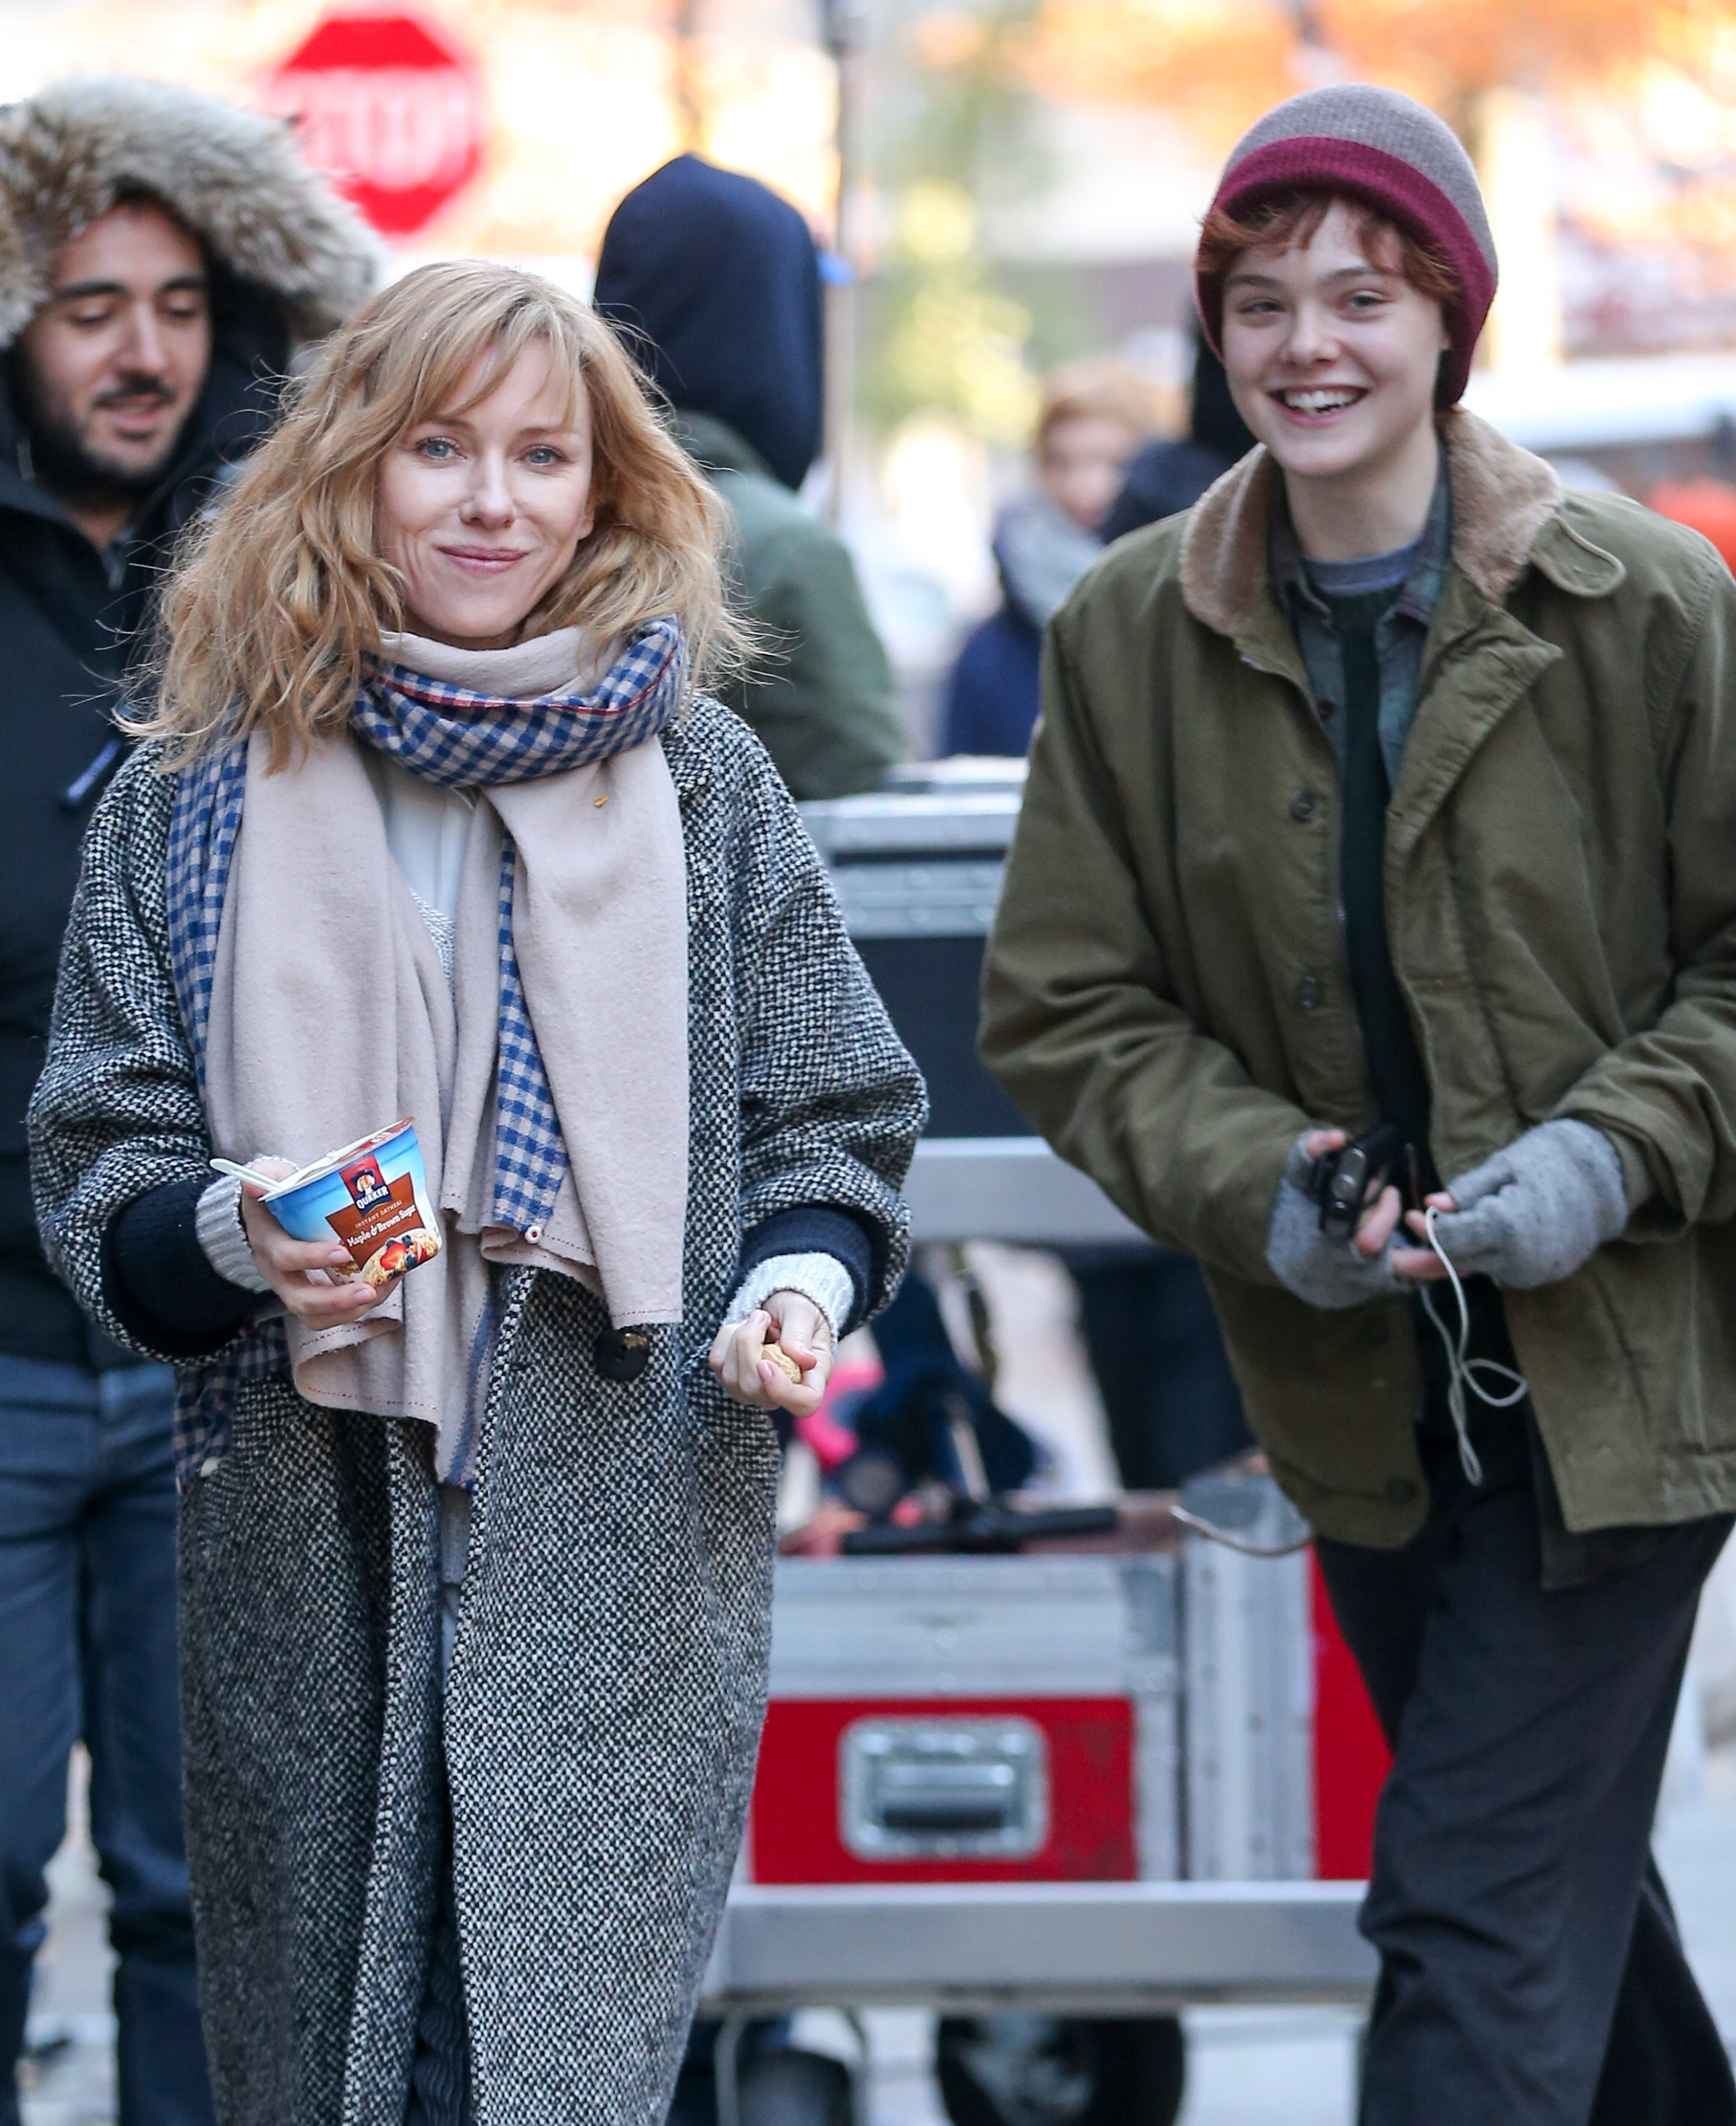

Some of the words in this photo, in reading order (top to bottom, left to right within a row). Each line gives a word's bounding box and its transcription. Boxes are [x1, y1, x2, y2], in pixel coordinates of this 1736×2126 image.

[356, 1186, 390, 1209] QUAKER
[346, 1231, 371, 1247] Maple
[370, 1225, 378, 1236] &
[376, 1215, 401, 1233] Brown
[399, 1204, 416, 1220] Sugar
[354, 1212, 380, 1229] INSTANT
[380, 1199, 403, 1216] OATMEAL
